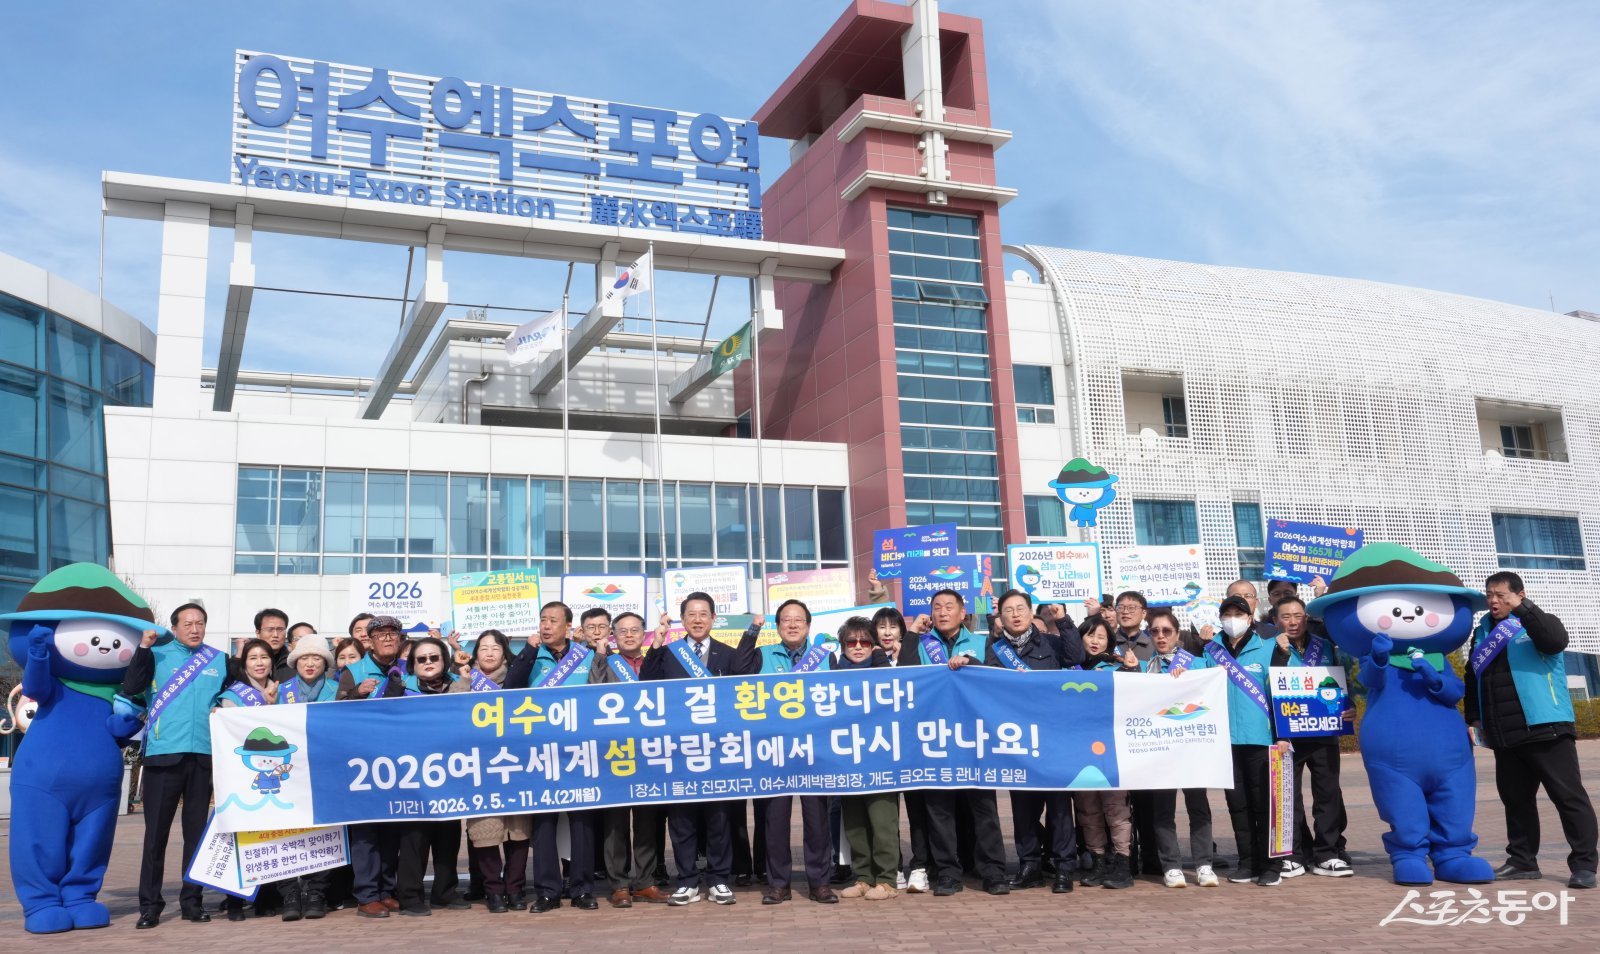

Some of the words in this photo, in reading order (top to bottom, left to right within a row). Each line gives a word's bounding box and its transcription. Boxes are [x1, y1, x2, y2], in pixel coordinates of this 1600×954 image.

[238, 54, 760, 209] 여수엑스포역
[236, 155, 432, 206] Yeosu-Expo
[444, 180, 556, 220] Station
[932, 547, 950, 557] 잇다
[1019, 550, 1053, 561] 2026년
[1281, 542, 1306, 554] 여수의
[1307, 546, 1333, 557] 365개
[1119, 562, 1200, 572] 2026여수세계섬박람회
[909, 576, 928, 584] 2026
[1139, 572, 1201, 583] 범시민준비위원회
[368, 581, 423, 600] 2026
[1052, 588, 1090, 598] 모입니다!
[367, 600, 424, 609] 여수세계섬박람회
[490, 611, 506, 619] 이용
[1497, 624, 1513, 638] 2026
[471, 697, 578, 738] 여수에
[592, 688, 666, 727] 오신
[684, 686, 717, 725] 걸
[733, 680, 915, 721] 환영합니다!
[1280, 702, 1309, 717] 여수로
[1125, 718, 1153, 727] 2026
[1289, 716, 1343, 733] 놀러오세요!
[1125, 723, 1218, 740] 여수세계섬박람회
[348, 730, 815, 792] 2026여수세계섬박람회에서
[831, 721, 902, 763] 다시
[917, 716, 1040, 759] 만나요!
[429, 796, 470, 815] 2026.
[671, 780, 699, 797] 돌산
[701, 778, 757, 794] 진모지구,
[760, 771, 866, 793] 여수세계박람회장,
[869, 770, 896, 788] 개도,
[939, 767, 954, 784] 등
[955, 765, 981, 783] 관내
[983, 766, 998, 783] 섬
[1000, 767, 1028, 785] 일원
[244, 844, 278, 861] 친절하게
[280, 838, 306, 852] 숙박객
[308, 829, 341, 847] 맞이하기
[245, 857, 280, 874] 위생용품
[281, 853, 298, 866] 한번
[299, 851, 309, 862] 더
[310, 844, 343, 860] 확인하기
